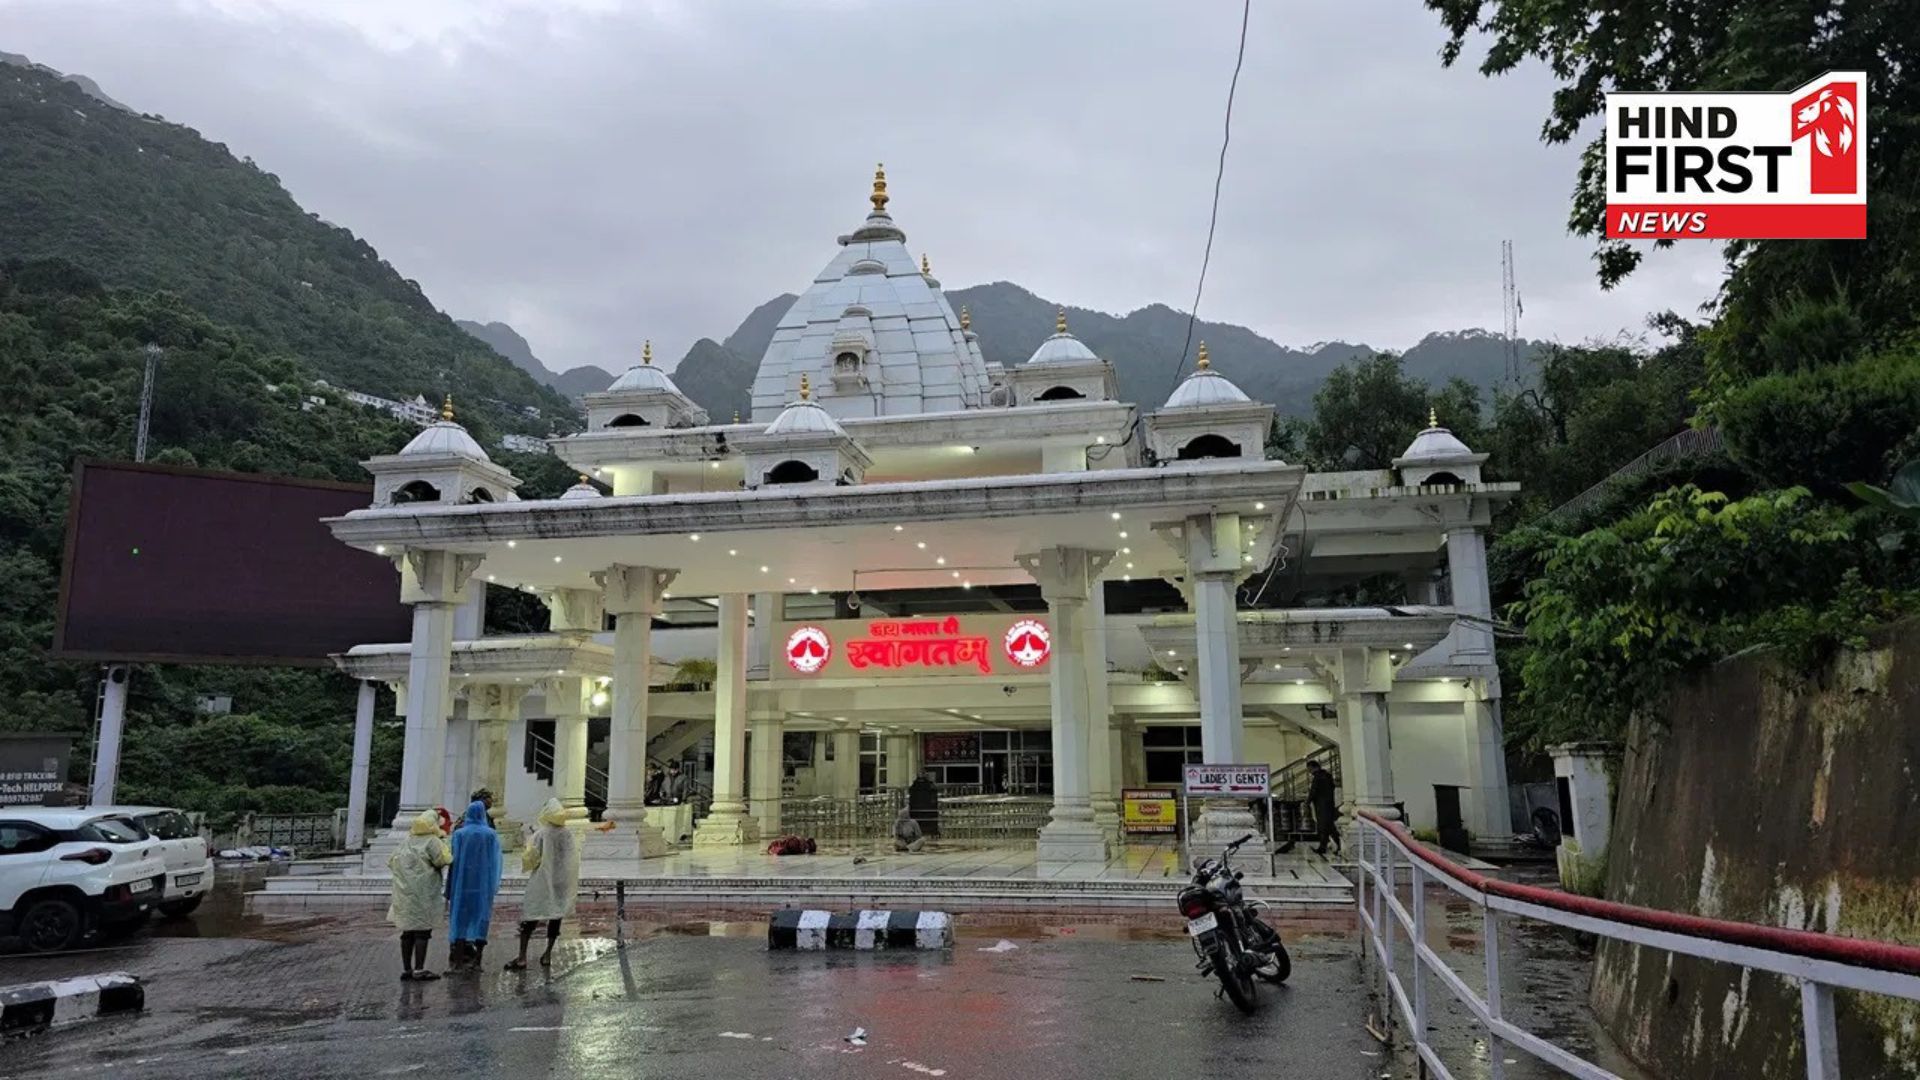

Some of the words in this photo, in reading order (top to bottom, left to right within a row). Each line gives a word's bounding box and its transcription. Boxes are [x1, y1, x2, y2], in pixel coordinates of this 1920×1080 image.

[870, 622, 900, 637] जय
[847, 638, 991, 673] स्वागतम्
[23, 772, 57, 780] TRACKING
[1200, 773, 1228, 784] LADIES
[1235, 773, 1266, 784] GENTS
[23, 782, 64, 792] HELPDESK
